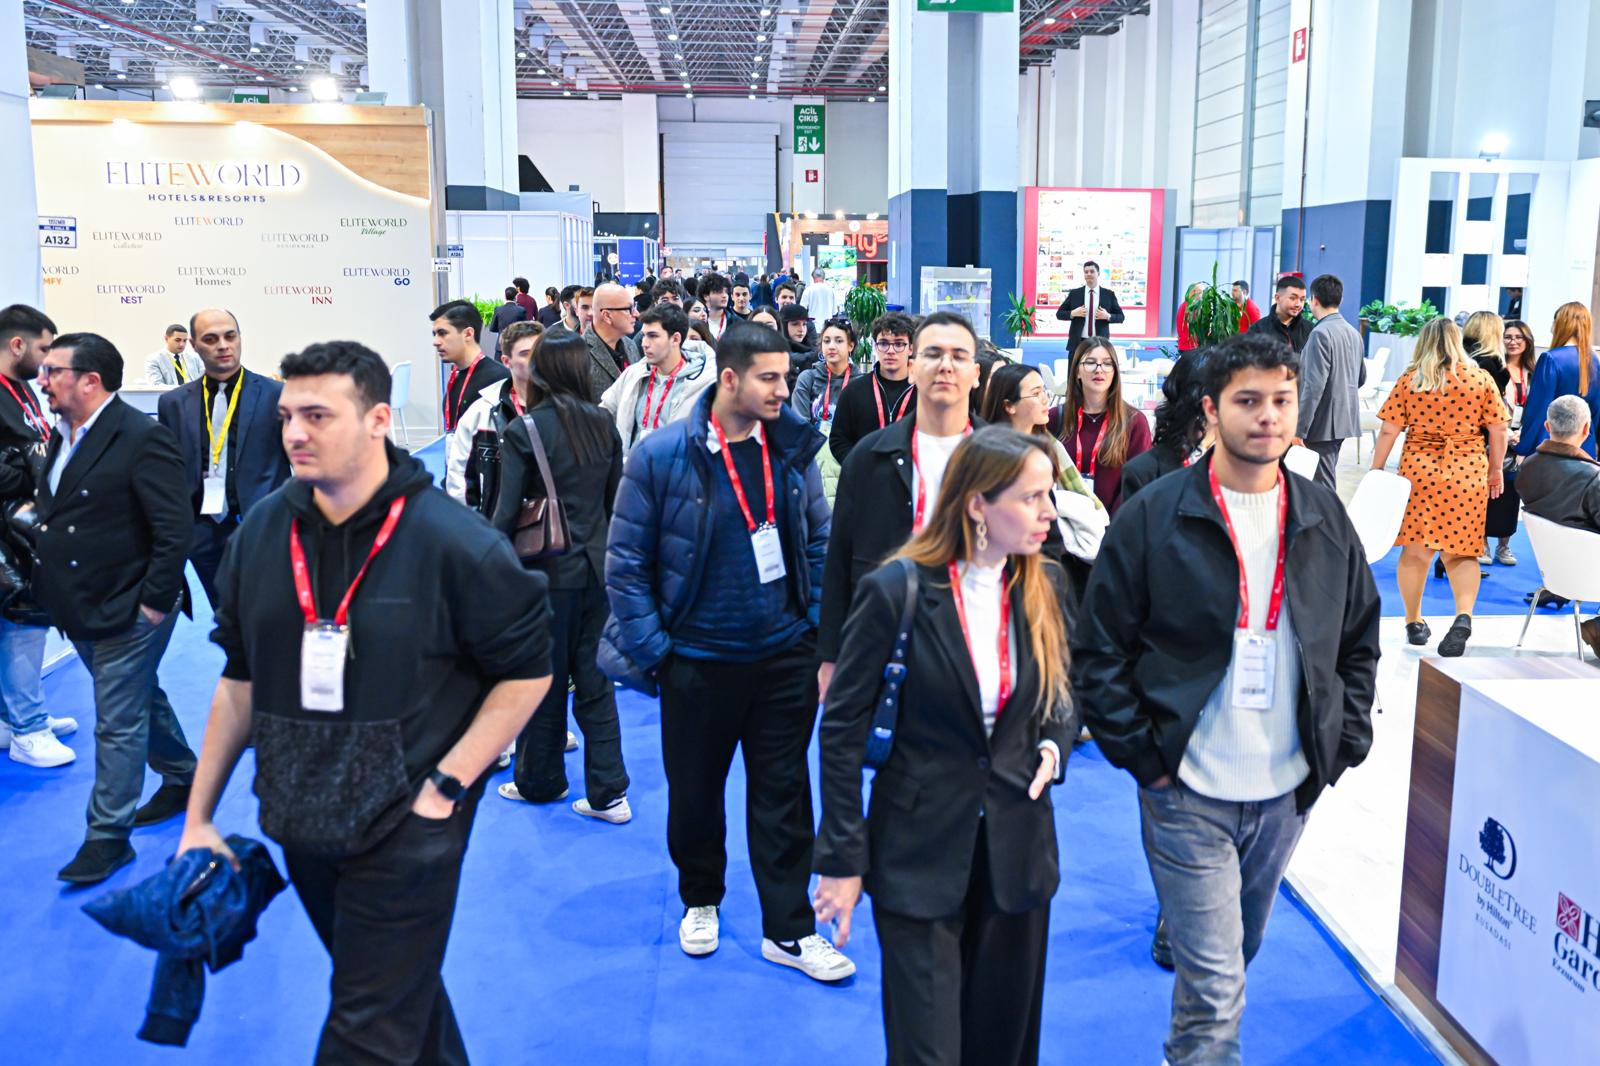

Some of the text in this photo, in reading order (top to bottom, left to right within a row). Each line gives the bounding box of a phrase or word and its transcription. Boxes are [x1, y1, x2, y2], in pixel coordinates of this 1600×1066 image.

[798, 115, 819, 123] ÇIKIŞ
[106, 161, 301, 187] ELITEWORLD
[148, 193, 267, 204] HOTELS&RESORTS
[174, 216, 244, 227] ELITEWORLD
[340, 217, 408, 228] ELITEWORLD
[44, 235, 71, 246] A132
[92, 231, 163, 241] ELITEWORLD
[260, 232, 329, 242] ELITEWORLD
[177, 266, 247, 276] ELITEWORLD
[343, 267, 410, 277] ELITEWORLD
[195, 276, 232, 287] Homes
[394, 277, 411, 287] GO
[96, 284, 166, 294] ELITEWORLD
[263, 285, 332, 295] ELITEWORLD
[120, 296, 144, 305] NEST
[311, 295, 333, 305] INN
[1459, 853, 1538, 935] DOUBLETREE
[1477, 892, 1511, 930] by Hilton
